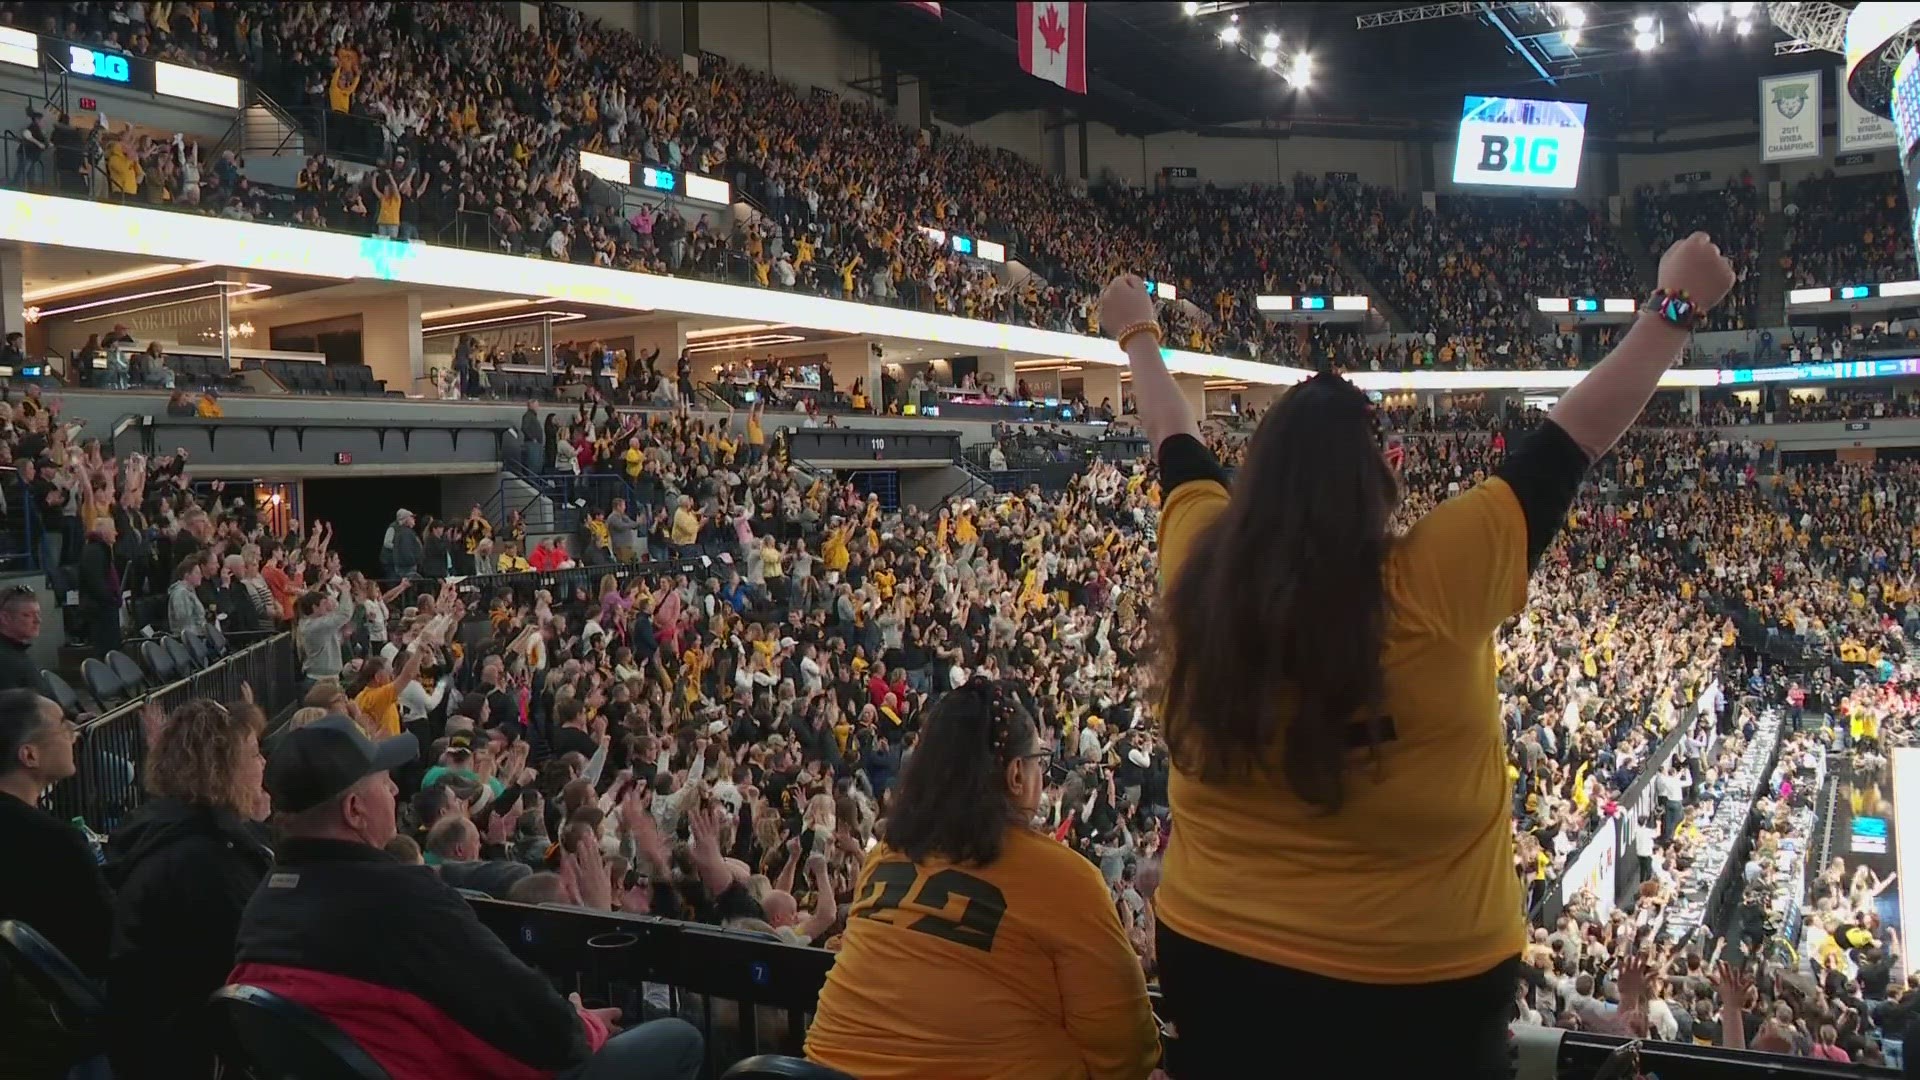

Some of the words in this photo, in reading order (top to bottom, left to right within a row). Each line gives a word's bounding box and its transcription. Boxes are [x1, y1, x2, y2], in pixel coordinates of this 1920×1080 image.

[1782, 126, 1799, 134] 2011
[1857, 125, 1882, 134] WNBA
[1779, 134, 1803, 142] WNBA
[1768, 141, 1815, 153] CHAMPIONS
[131, 303, 217, 330] NORTHROCK
[871, 438, 885, 450] 110
[525, 929, 532, 941] 8
[755, 966, 763, 980] 7
